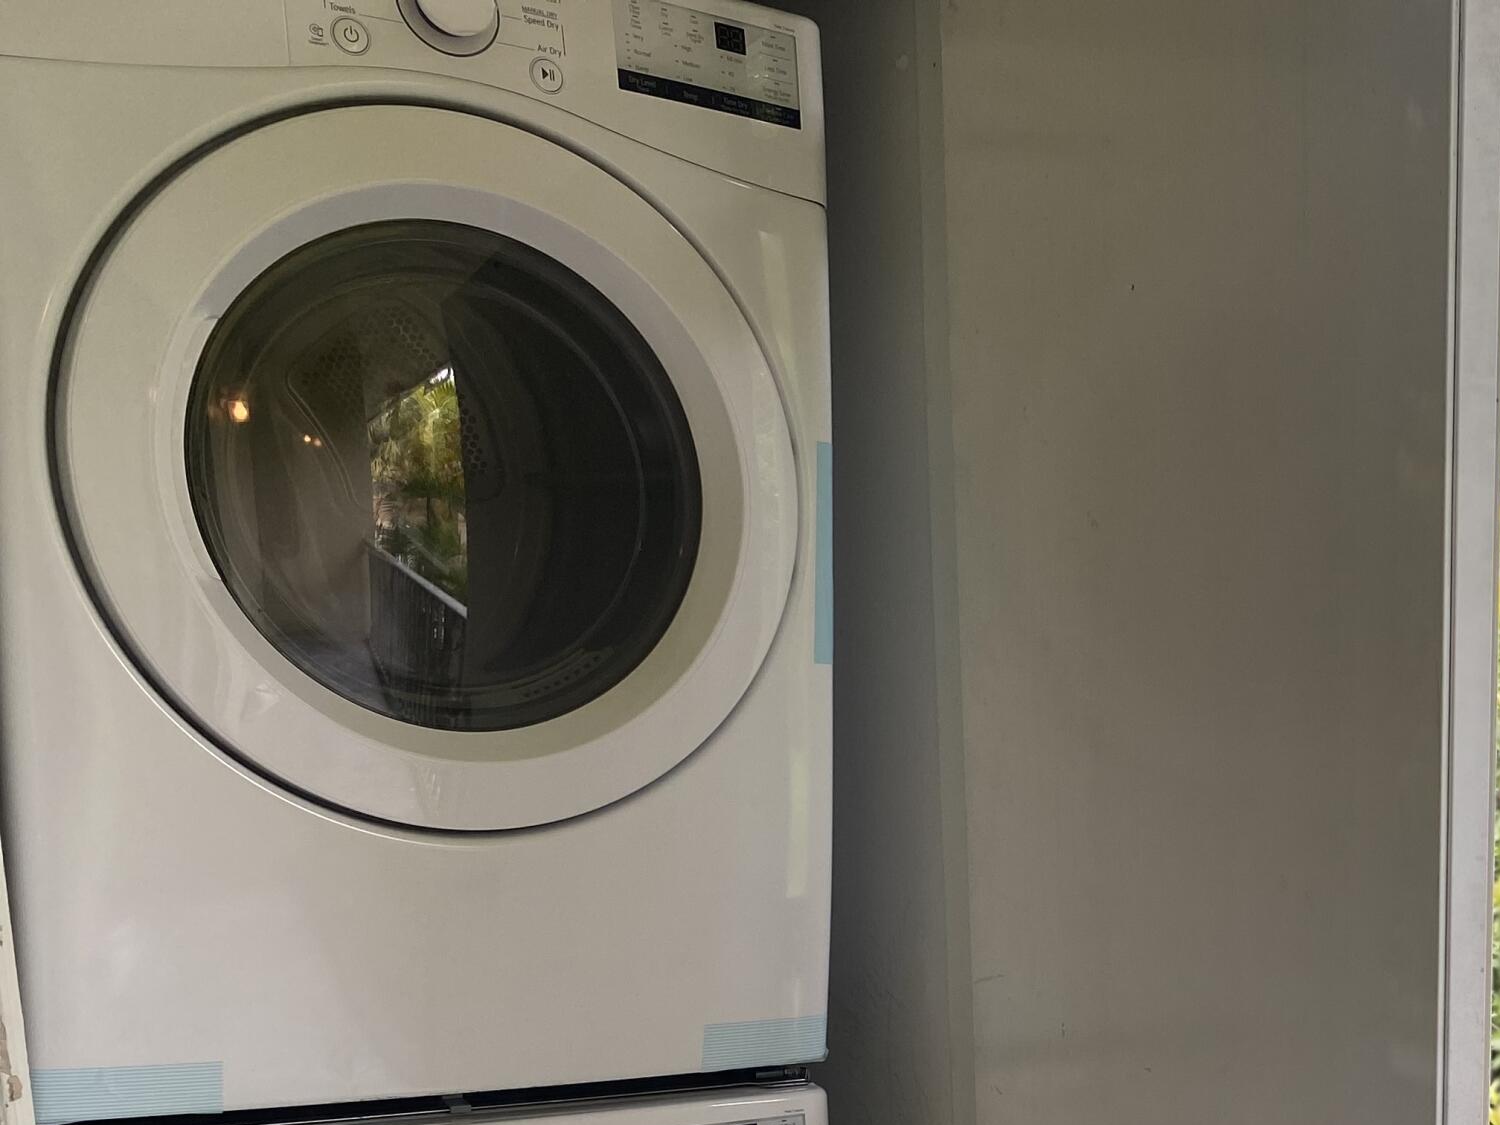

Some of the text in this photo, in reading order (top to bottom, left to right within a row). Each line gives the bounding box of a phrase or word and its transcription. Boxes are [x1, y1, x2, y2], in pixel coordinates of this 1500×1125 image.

[330, 2, 356, 14] Towels
[523, 14, 559, 32] Speed Dry
[537, 44, 562, 58] Air Dry
